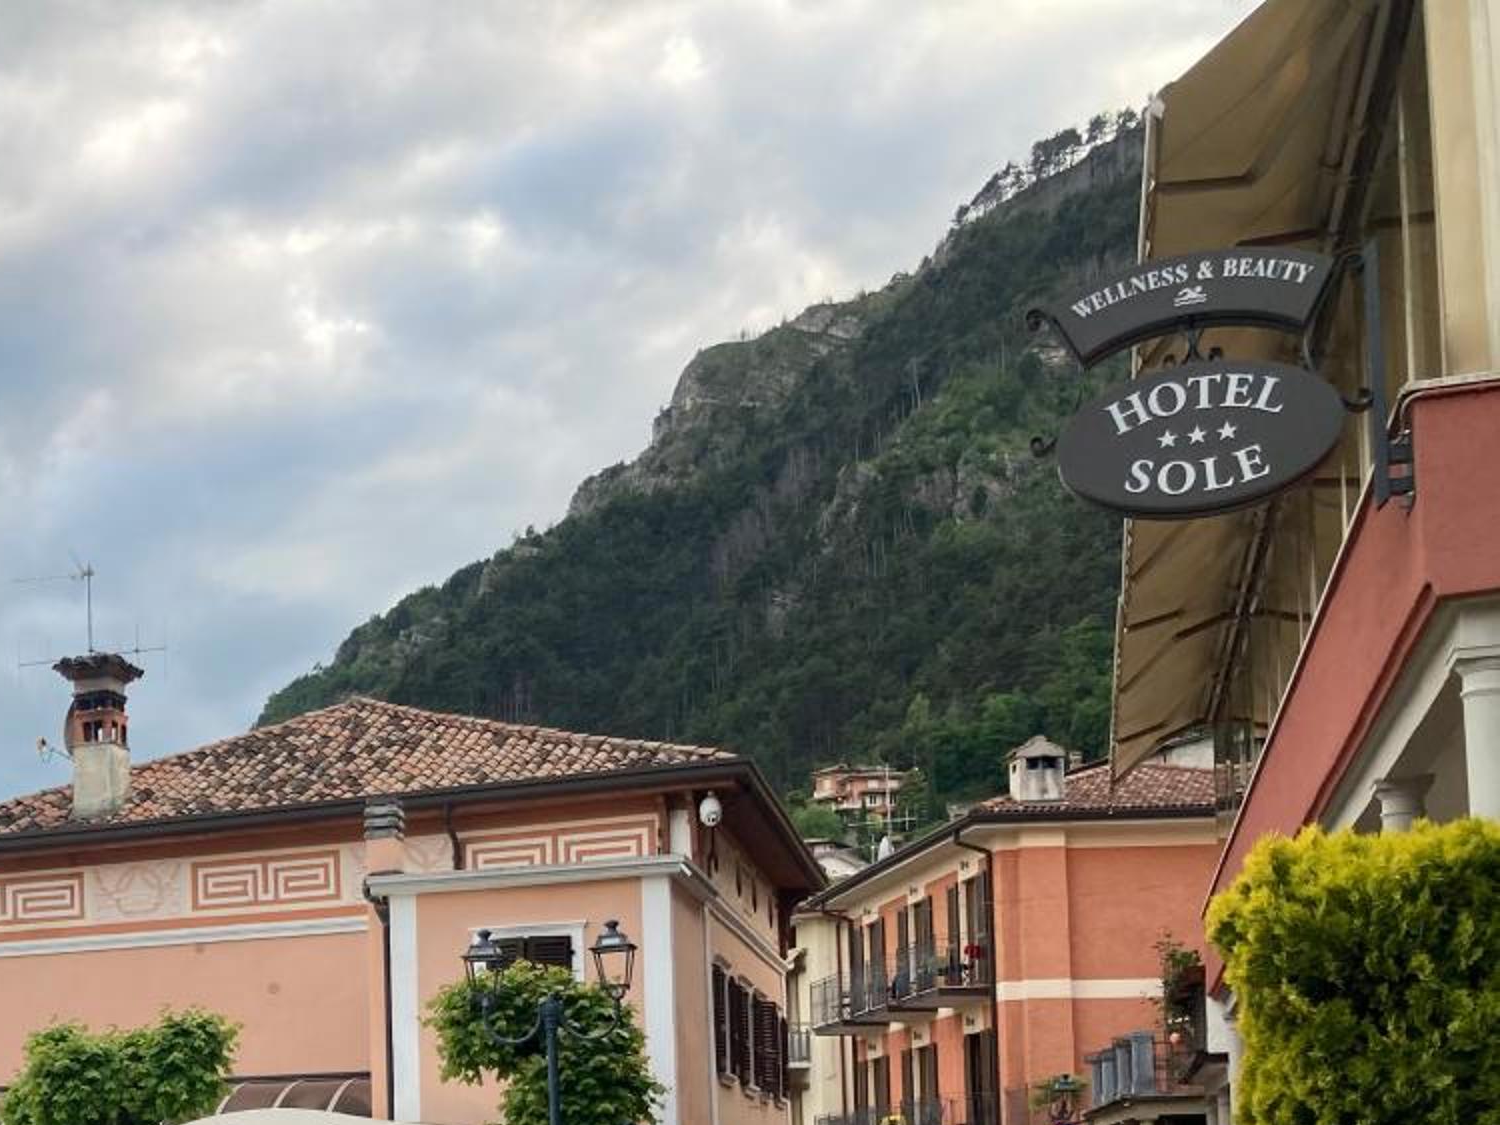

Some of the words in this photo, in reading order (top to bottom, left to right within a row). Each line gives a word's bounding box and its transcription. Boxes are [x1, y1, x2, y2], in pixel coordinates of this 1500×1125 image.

[1071, 263, 1189, 318] WELLNESS
[1196, 259, 1215, 281] &
[1222, 257, 1315, 285] BEAUTY
[1104, 373, 1284, 435] HOTEL
[1123, 444, 1271, 496] SOLE
